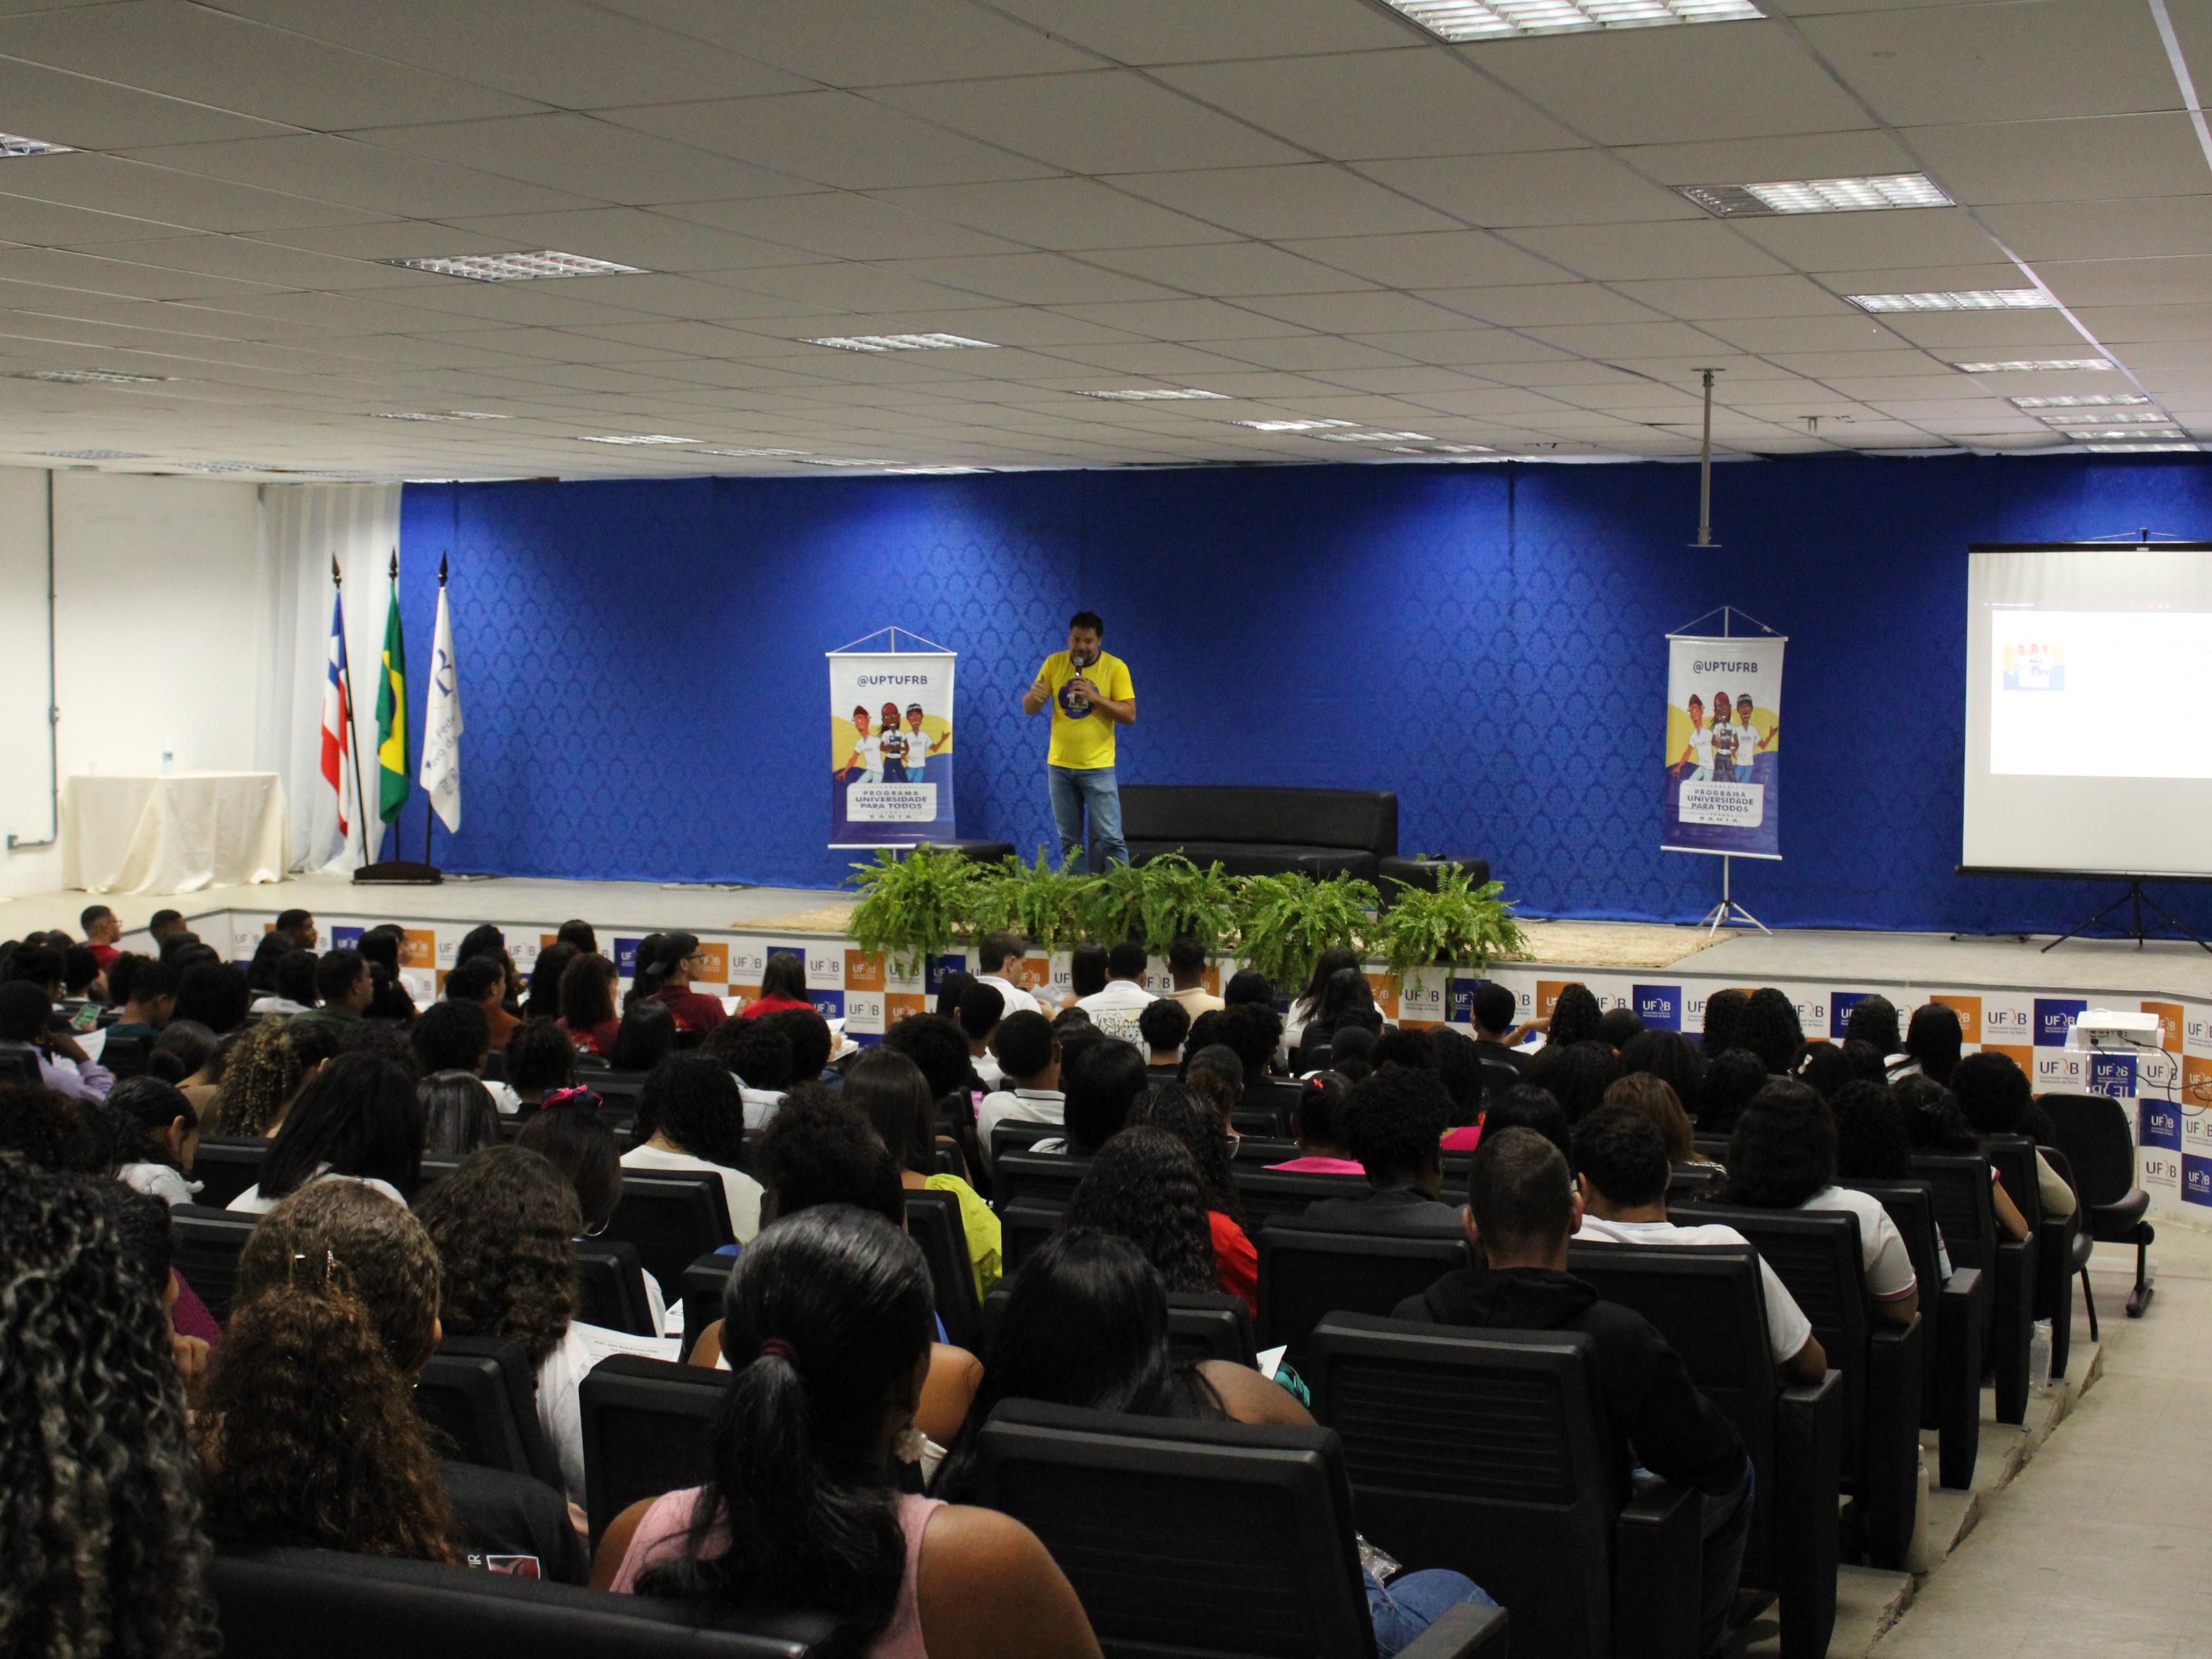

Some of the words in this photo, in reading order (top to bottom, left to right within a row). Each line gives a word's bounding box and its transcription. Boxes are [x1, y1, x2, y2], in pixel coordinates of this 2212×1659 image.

[1693, 661, 1758, 674] @UPTUFRB
[857, 675, 928, 687] @UPTUFRB
[1695, 789, 1746, 797] PROGRAMA
[1688, 795, 1754, 805] UNIVERSIDADE
[1643, 998, 1671, 1011] UFRB
[1988, 1009, 2026, 1026] UFRB
[2040, 1058, 2079, 1075] UFRB
[2147, 1160, 2177, 1178] UFRB
[2189, 1171, 2210, 1186] UFRB
